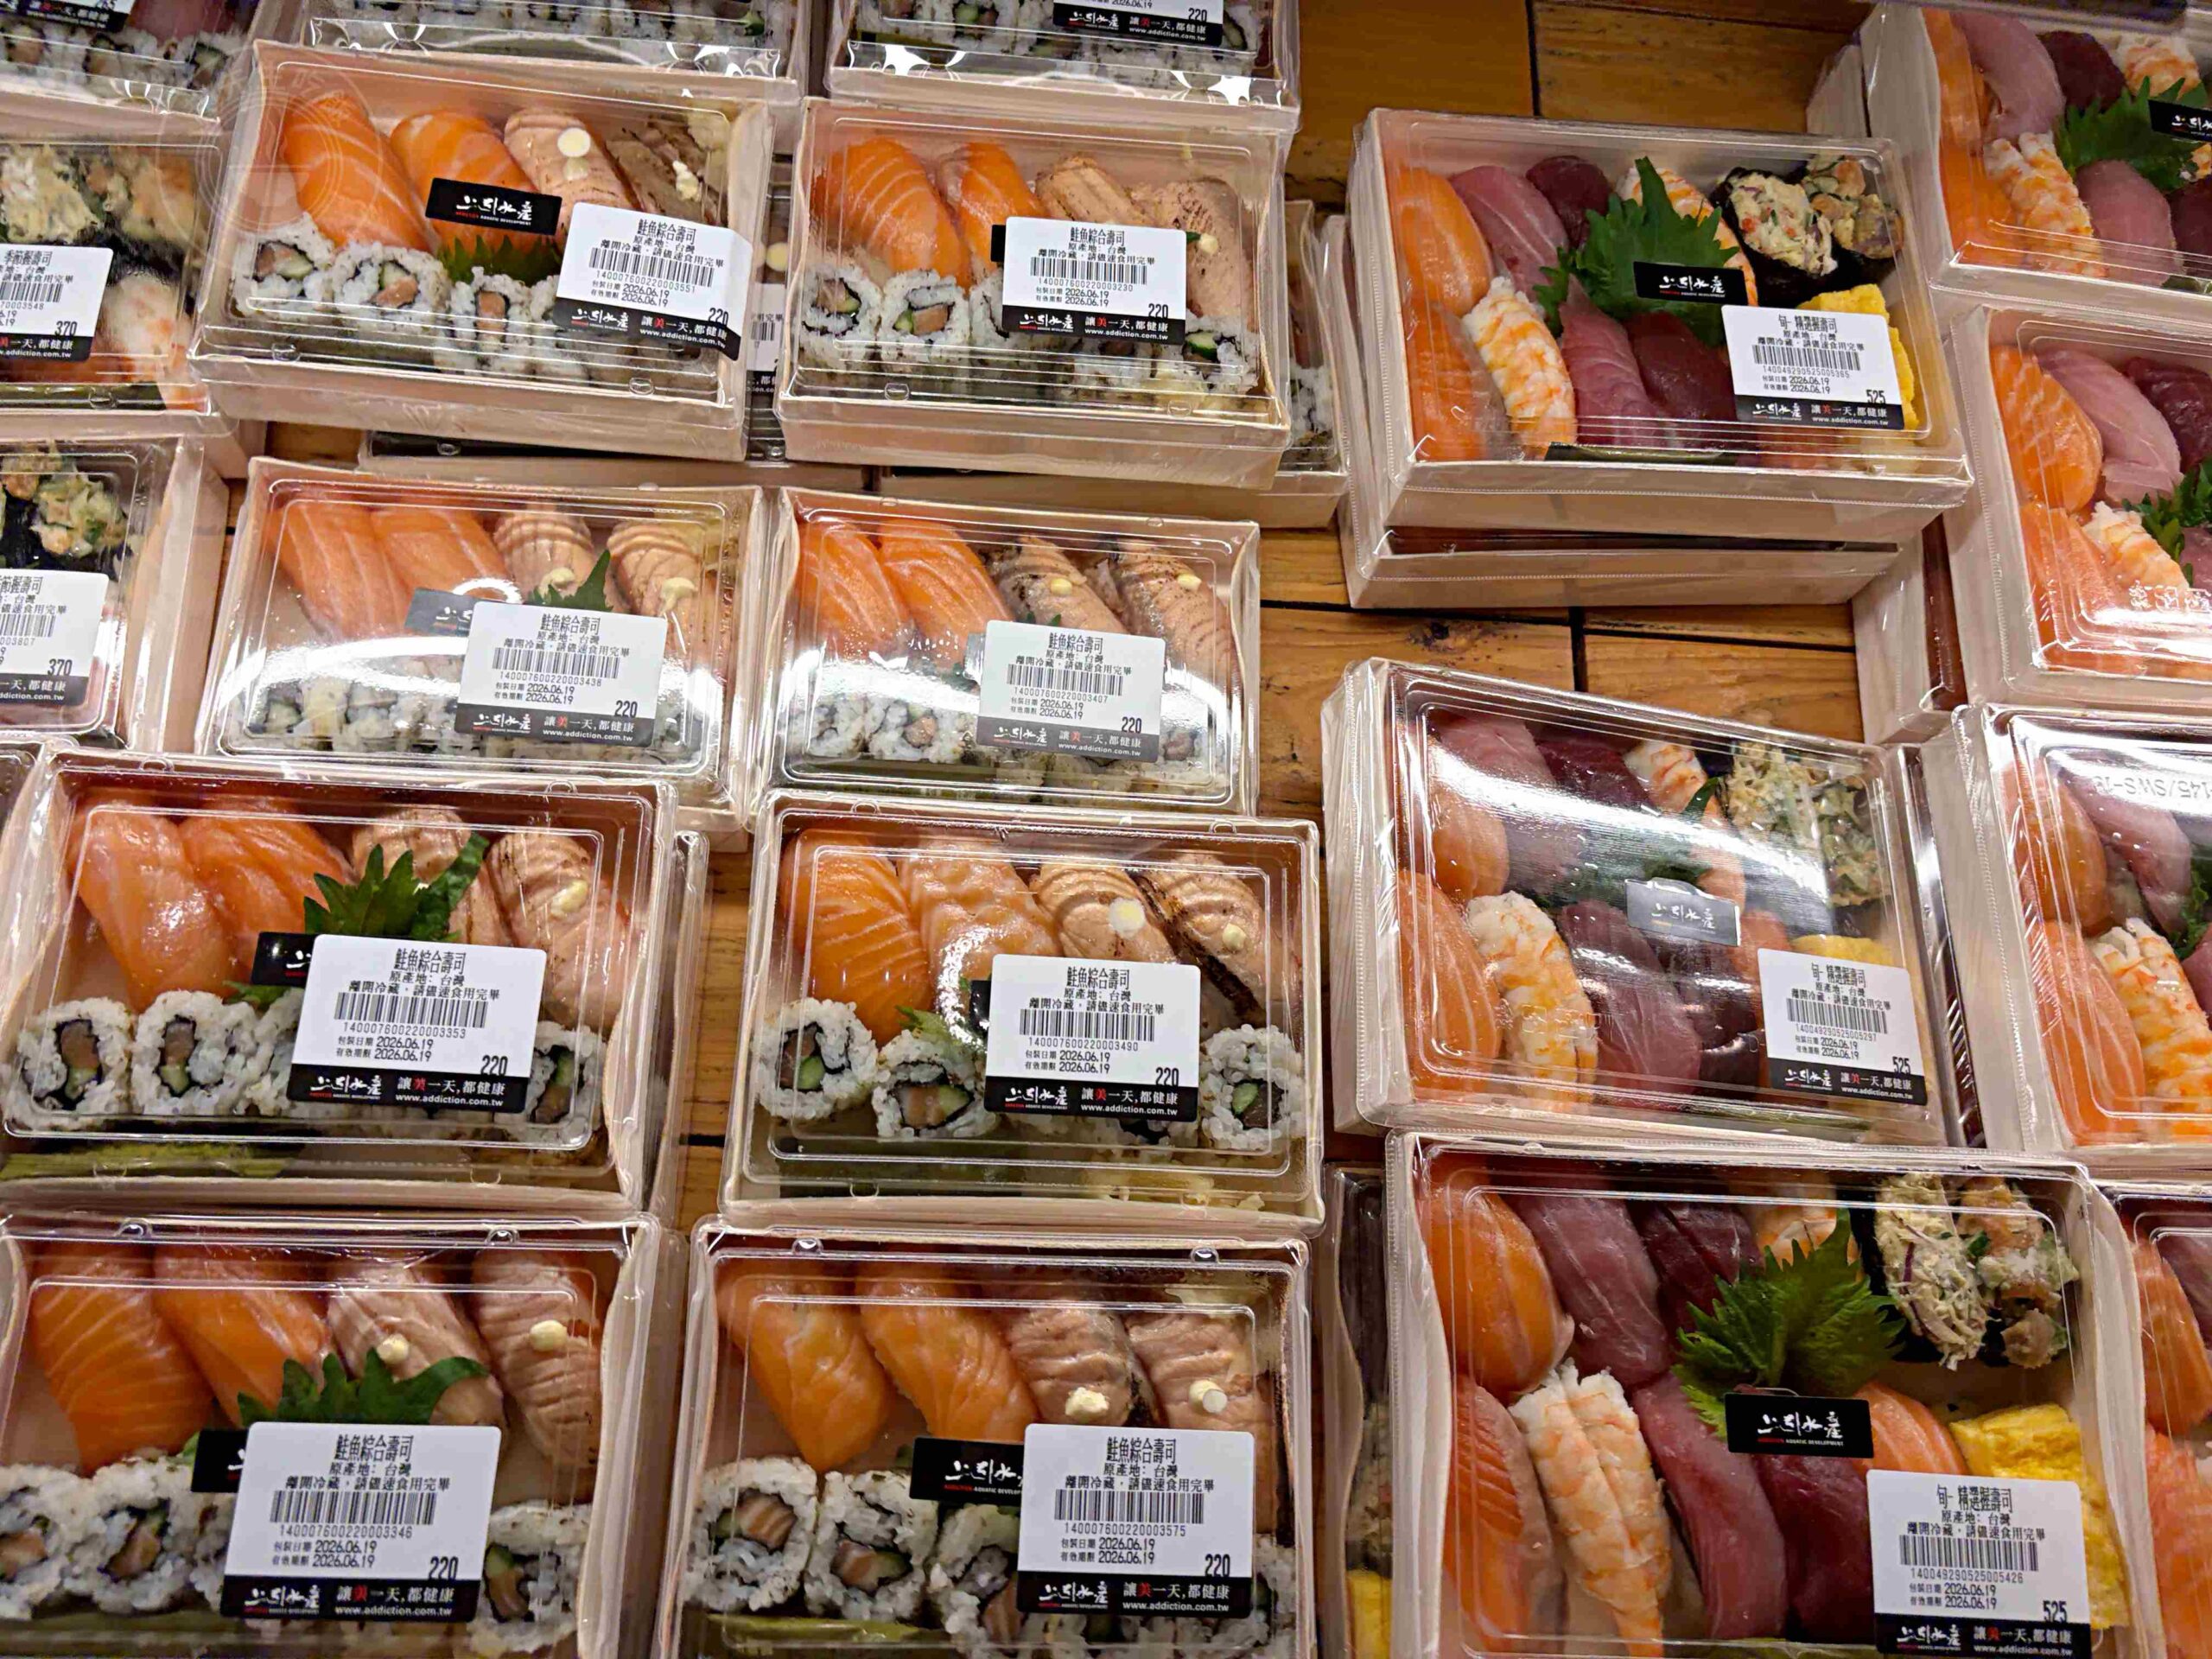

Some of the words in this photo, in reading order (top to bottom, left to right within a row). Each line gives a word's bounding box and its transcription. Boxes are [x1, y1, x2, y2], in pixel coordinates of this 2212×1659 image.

[1188, 8, 1207, 22] 220
[1128, 27, 1206, 41] www.addiction.com.tw
[1070, 227, 1124, 246] 鮭魚綜合壽司
[623, 283, 670, 298] 2026.06.19
[1039, 277, 1133, 292] 140007600220003230
[621, 292, 668, 307] 2026.06.19
[1065, 288, 1109, 298] 2026.06.19
[1065, 296, 1109, 307] 2026.06.19
[709, 308, 729, 326] 220
[1147, 302, 1168, 319] 220
[54, 321, 78, 336] 370
[1084, 328, 1168, 340] www.addiction.com.tw
[640, 328, 725, 348] www.addiction.com.tw
[1789, 375, 1829, 385] 2026.06.19
[1789, 384, 1830, 394] 2026.06.19
[1866, 389, 1887, 404] 525
[540, 613, 601, 635] 鮭魚綜合壽司
[1048, 632, 1103, 654] 鮭魚綜合壽司
[47, 658, 73, 676] 370
[527, 683, 575, 695] 2026.06.19
[525, 692, 574, 704] 2026.06.19
[1040, 698, 1084, 711] 2026.06.19
[613, 700, 638, 717] 220
[1039, 707, 1083, 720] 2026.06.19
[1121, 716, 1141, 733] 220
[543, 729, 632, 741] www.addiction.com.tw
[1058, 743, 1141, 756] www.addiction.com.tw
[394, 948, 466, 975] 鮭魚綜合壽司
[1066, 966, 1129, 989] 鮭魚綜合壽司
[344, 1022, 466, 1039] 140007600220003353
[376, 1036, 433, 1050] 2026.06.19
[1029, 1037, 1138, 1052] 140007600220003490
[1821, 1037, 1858, 1050] 2026.06.19
[374, 1047, 431, 1061] 2026.06.19
[1059, 1050, 1110, 1062] 2026.06.19
[1821, 1046, 1859, 1059] 2026.06.19
[480, 1054, 508, 1076] 220
[1058, 1061, 1109, 1073] 2026.06.19
[1892, 1056, 1912, 1075] 525
[1155, 1066, 1179, 1087] 220
[396, 1095, 503, 1106] www.addiction.com.tw
[1081, 1104, 1177, 1115] www.addiction.com.tw
[334, 1434, 413, 1462] 鮭魚綜合壽司
[1107, 1437, 1176, 1464] 鮭魚綜合壽司
[945, 1459, 1023, 1487] 上引水
[1065, 1522, 1185, 1536] 140007600220003575
[315, 1540, 377, 1554] 2026.06.19
[1099, 1536, 1155, 1550] 2026.06.19
[312, 1554, 375, 1567] 2026.06.19
[1098, 1550, 1154, 1564] 2026.06.19
[427, 1556, 458, 1580] 220
[1205, 1554, 1230, 1577] 220
[1944, 1582, 1996, 1596] 2026.06.19
[1122, 1601, 1229, 1611] www.addiction.com.tw
[1945, 1595, 1997, 1609] 2026.06.19
[335, 1605, 451, 1616] www.addiction.com.tw
[2043, 1600, 2067, 1622] 525
[1974, 1645, 2072, 1656] www.addiction.com.tw
